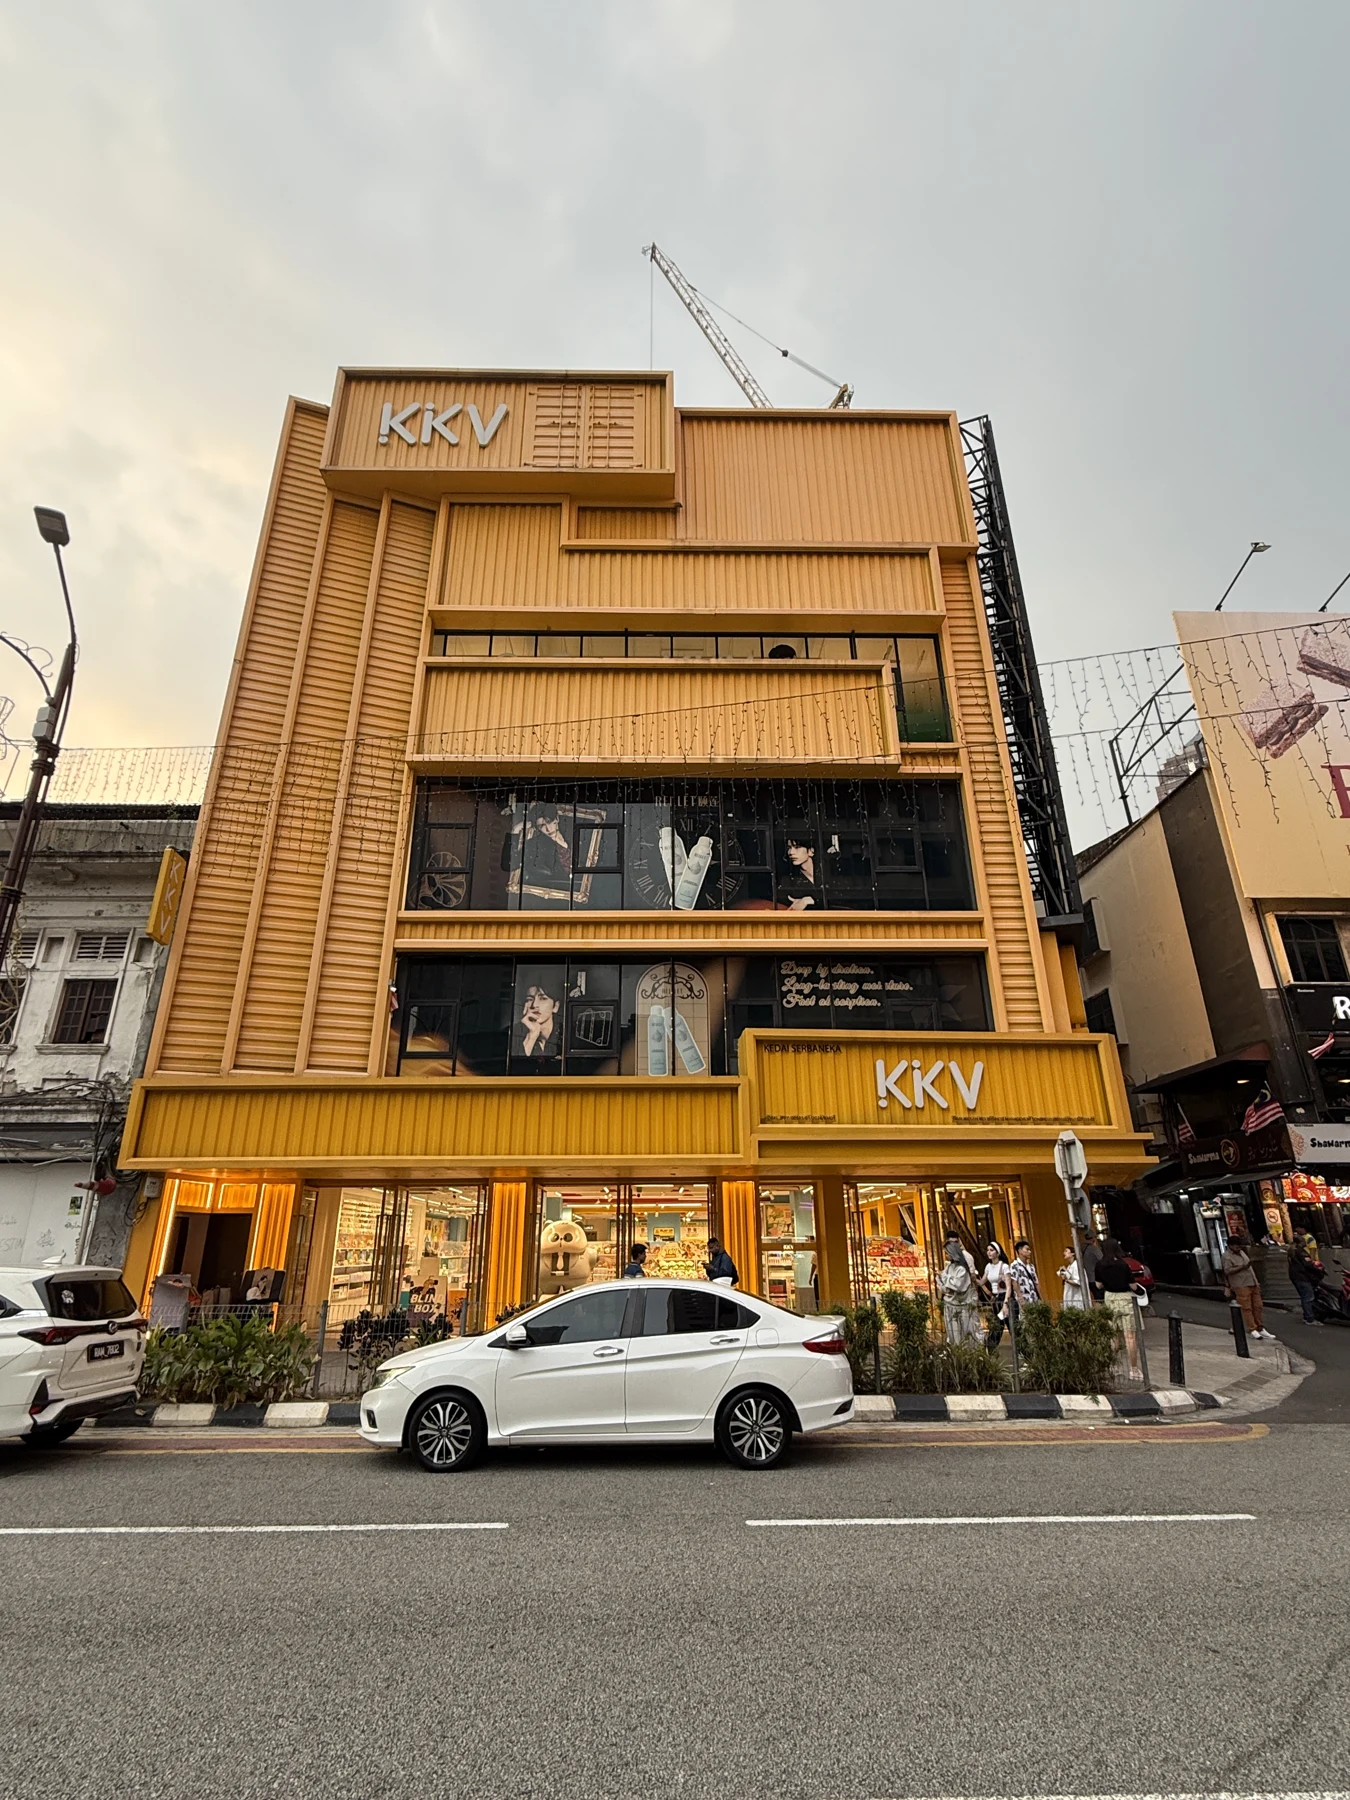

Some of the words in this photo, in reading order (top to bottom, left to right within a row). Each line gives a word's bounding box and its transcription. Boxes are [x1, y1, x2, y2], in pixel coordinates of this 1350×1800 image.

[781, 961, 812, 977] Deep
[816, 963, 874, 978] hydration.
[781, 976, 859, 994] Long-lasting
[783, 993, 816, 1008] Fast
[764, 1044, 789, 1053] KEDAI
[791, 1044, 842, 1053] SERBANEKA
[410, 1293, 443, 1303] BLIND
[414, 1304, 437, 1313] BOX
